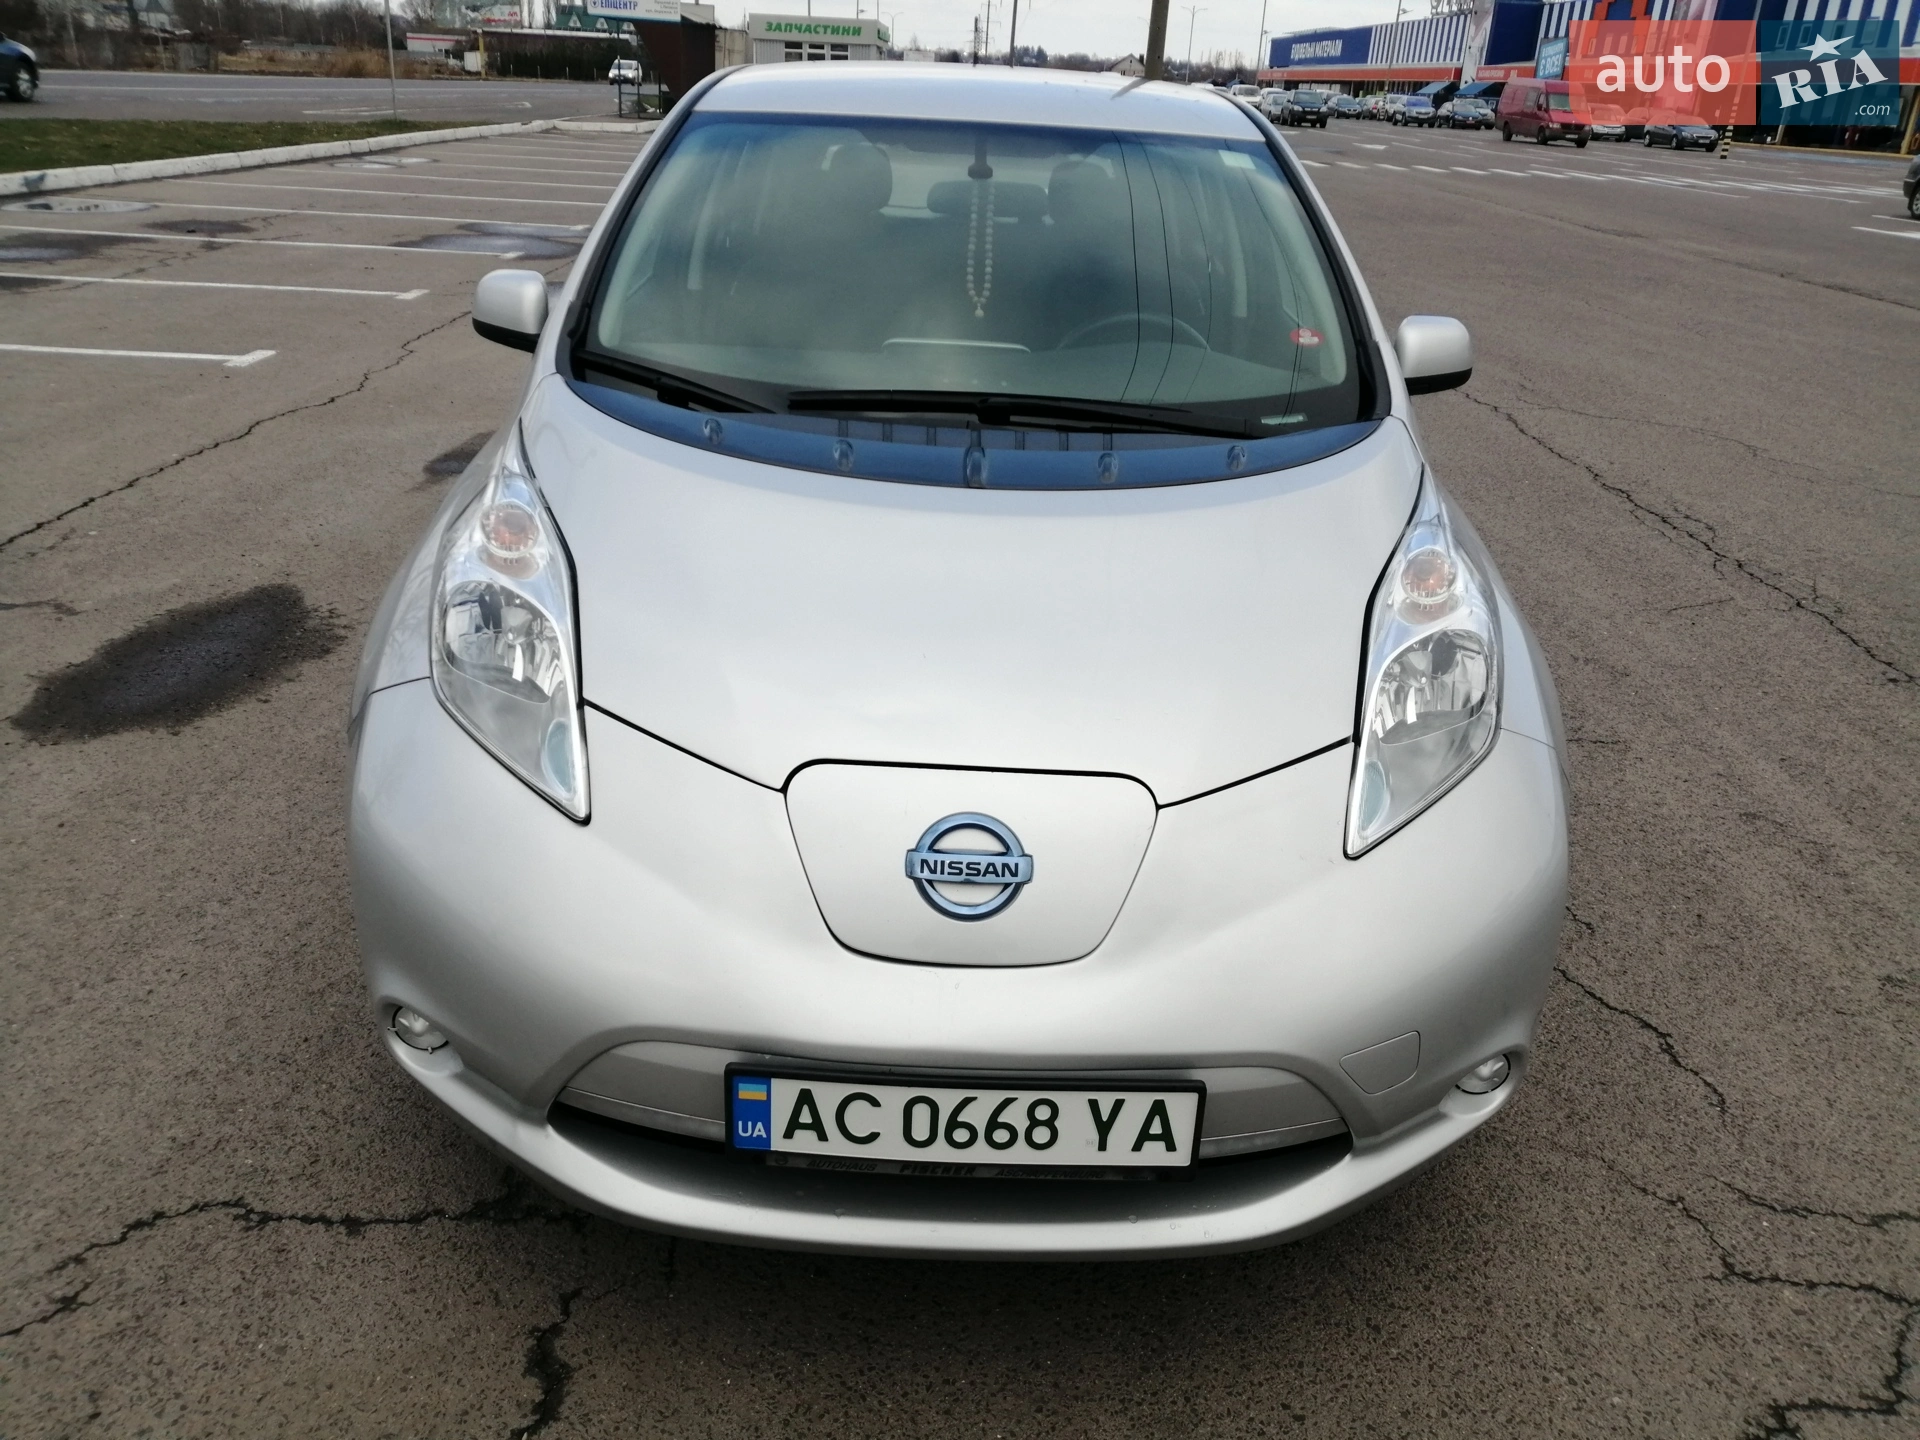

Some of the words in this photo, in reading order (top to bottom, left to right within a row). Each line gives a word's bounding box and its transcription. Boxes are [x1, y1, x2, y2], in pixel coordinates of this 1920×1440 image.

[600, 0, 638, 11] ЕПІЦЕНТР
[764, 21, 862, 37] ЗАПЧАСТИНИ
[919, 858, 1019, 878] NISSAN
[737, 1120, 767, 1139] UA
[782, 1088, 882, 1145] AC
[902, 1095, 1060, 1151] 0668
[1087, 1098, 1177, 1152] YA
[806, 1158, 878, 1172] AUTOHAUS
[899, 1163, 977, 1177] FISCHER
